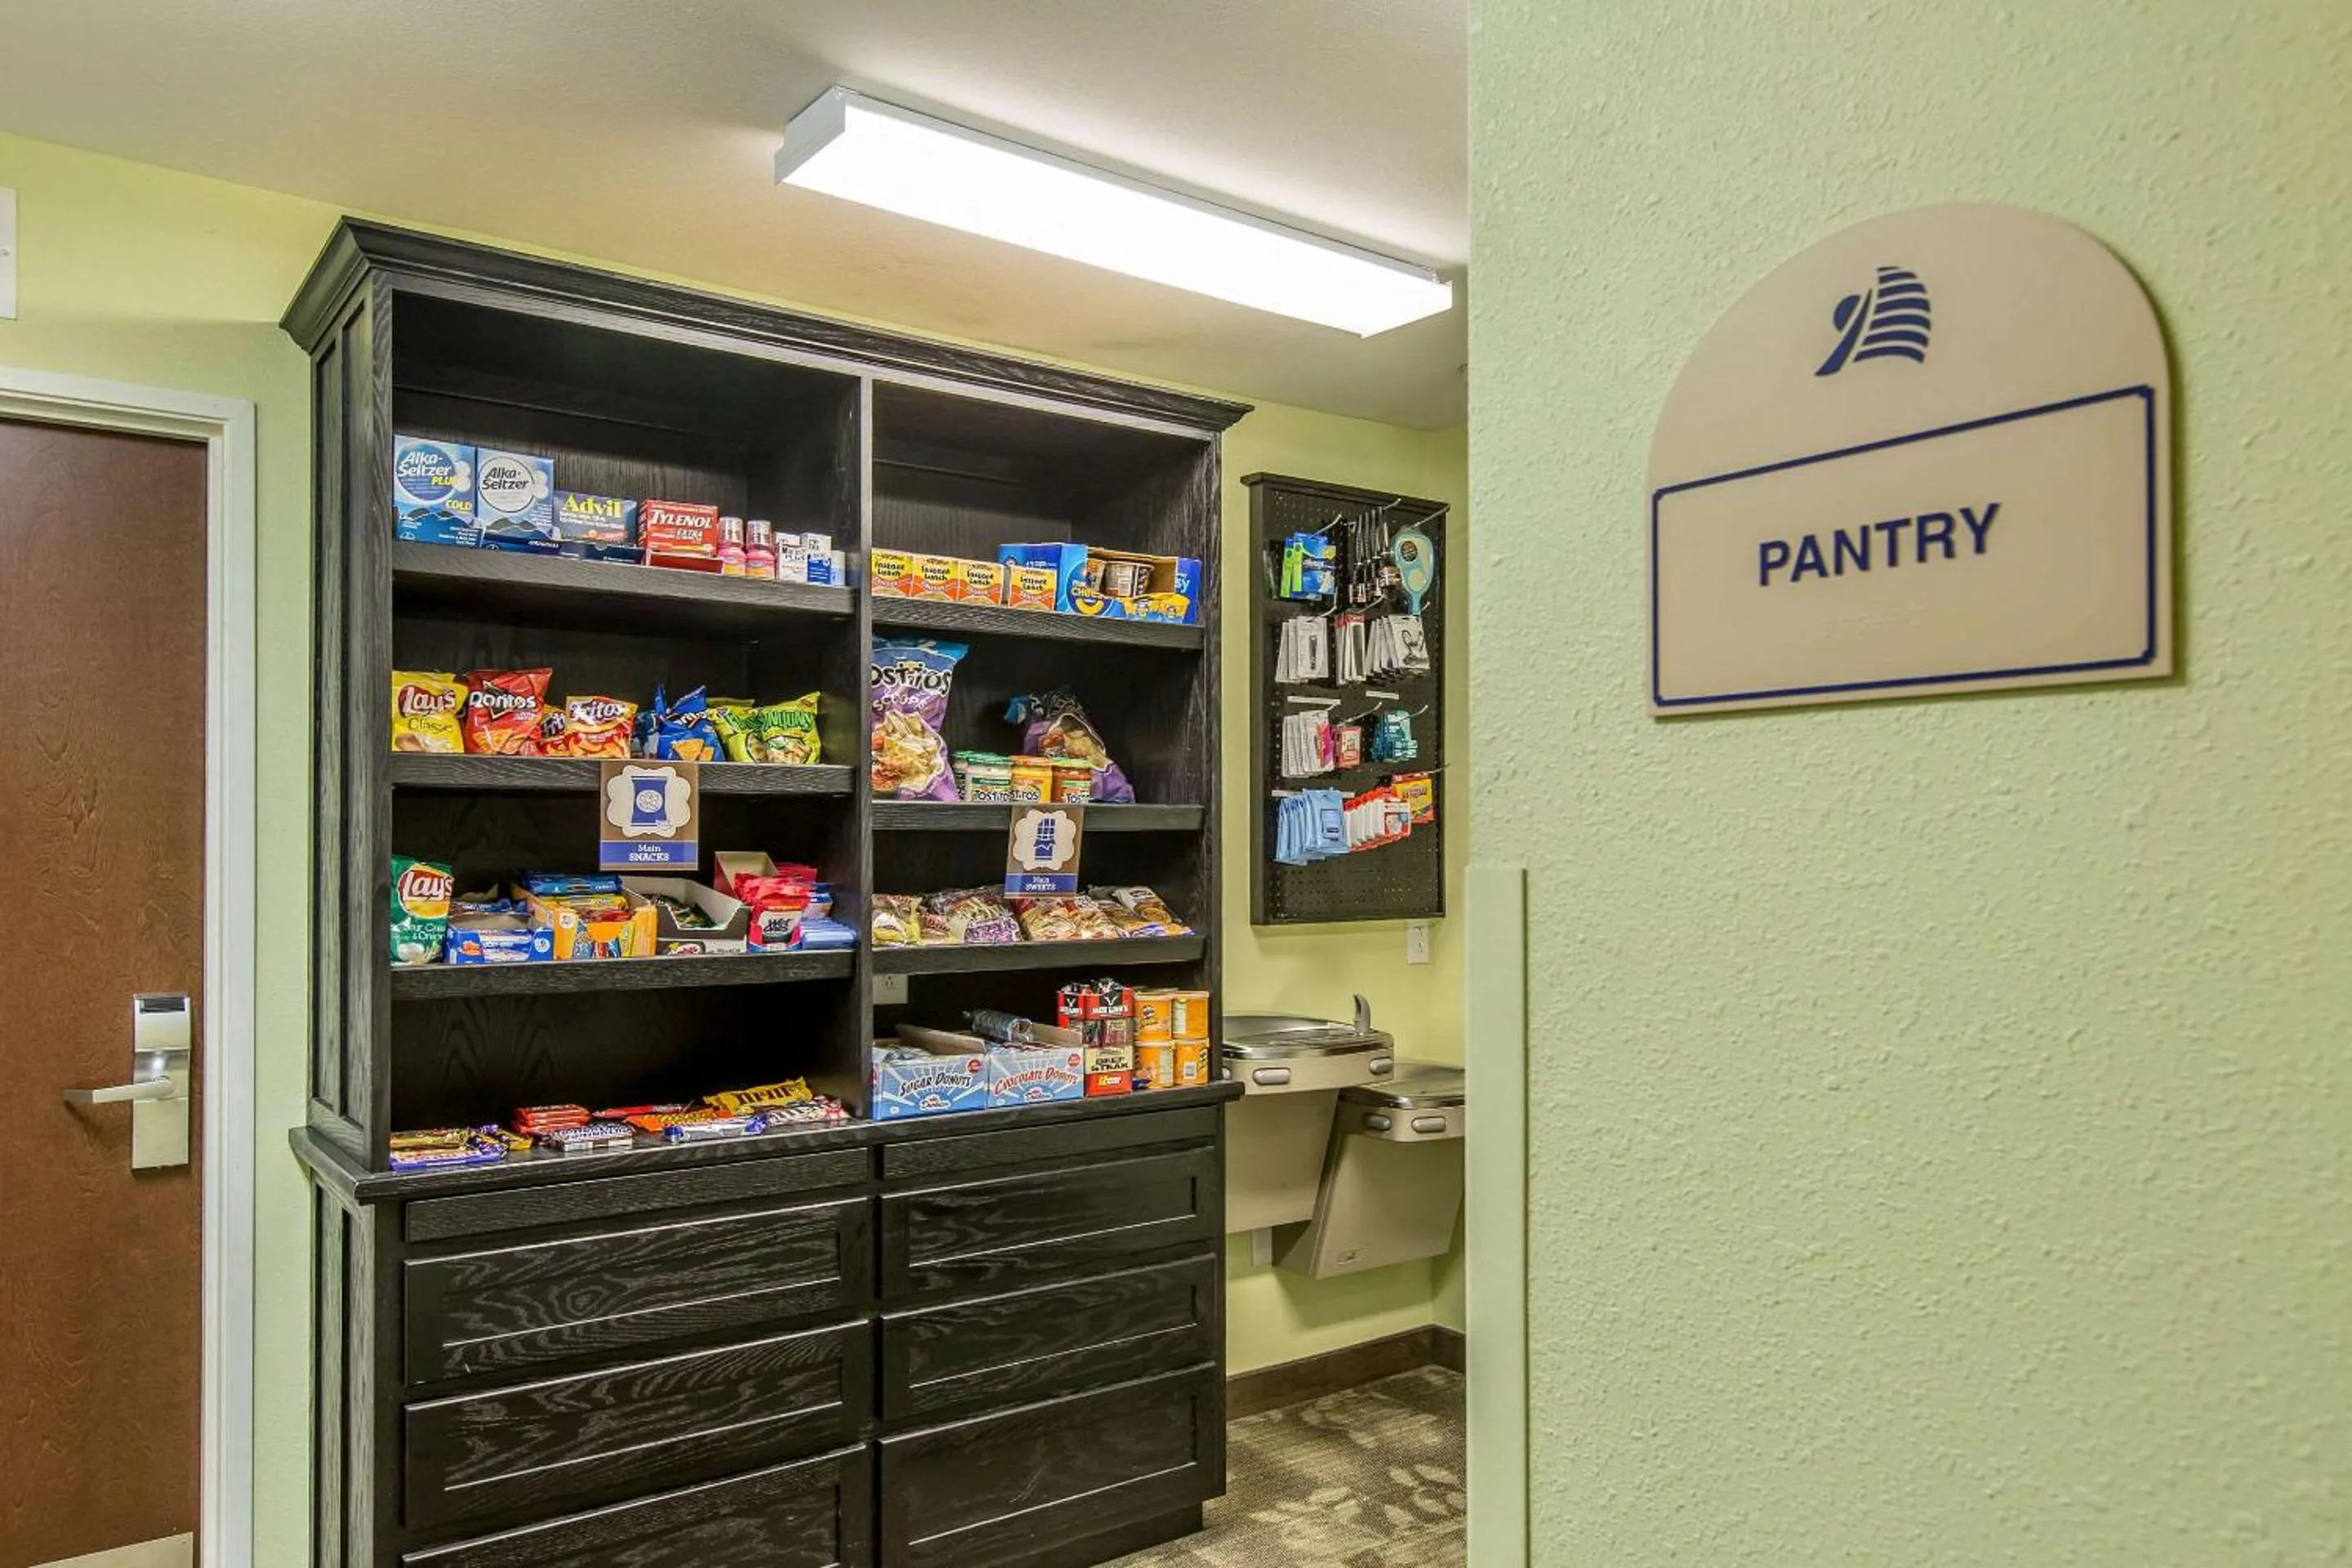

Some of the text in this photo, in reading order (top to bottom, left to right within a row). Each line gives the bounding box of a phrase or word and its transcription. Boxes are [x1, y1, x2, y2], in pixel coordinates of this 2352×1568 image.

[405, 451, 443, 466] Alka-
[398, 463, 452, 477] Seltzer
[484, 466, 521, 479] Alka-
[481, 478, 529, 490] Seltzer
[445, 499, 472, 511] COLD
[562, 492, 621, 519] Advil
[651, 509, 713, 528] TYLENOL
[1759, 502, 2001, 586] PANTRY
[871, 666, 952, 696] OSTITOS
[403, 686, 456, 717] Lay's
[470, 691, 537, 709] Doritos
[628, 853, 670, 862] SNACKS
[402, 871, 453, 902] Lay's
[899, 1072, 973, 1097] SUGAR DONUTS
[995, 1070, 1043, 1095] CHOCOLATE
[1044, 1067, 1079, 1085] DONUTS
